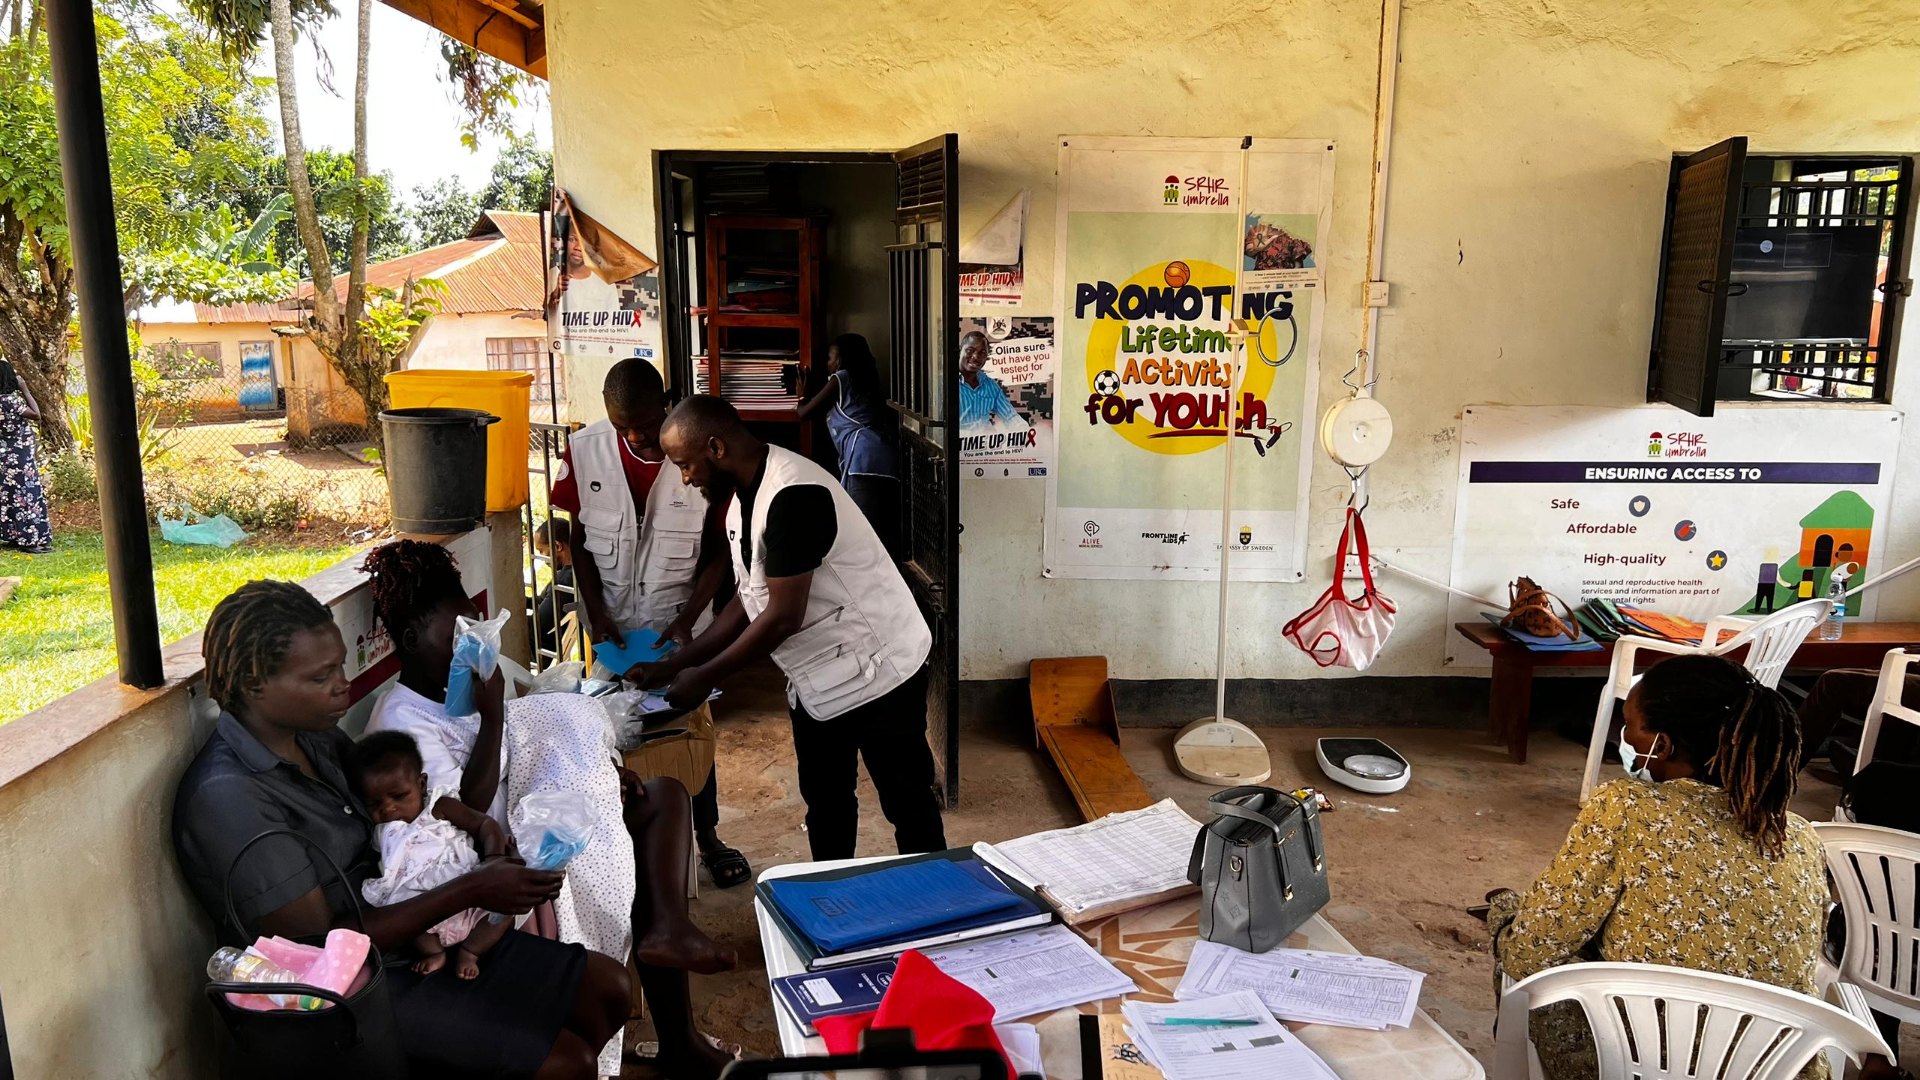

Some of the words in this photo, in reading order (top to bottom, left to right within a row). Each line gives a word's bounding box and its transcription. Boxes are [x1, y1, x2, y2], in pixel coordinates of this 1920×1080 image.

[1184, 176, 1229, 194] SRHR
[1183, 192, 1228, 206] umbrella
[978, 274, 990, 286] UP
[992, 274, 1008, 285] HIV
[1075, 281, 1294, 321] PROMOTNG
[562, 312, 590, 326] TIME
[593, 312, 609, 326] UP
[612, 311, 632, 326] HIV
[996, 346, 1021, 355] Olina
[1024, 344, 1046, 352] sure
[992, 357, 1006, 366] but
[1008, 356, 1031, 364] have
[1034, 353, 1050, 362] you
[1000, 364, 1028, 374] tested
[1012, 372, 1034, 382] HIV?
[1084, 393, 1144, 426] for
[959, 436, 986, 451] TIME
[989, 434, 1004, 449] UP
[1007, 432, 1027, 446] HIV
[1667, 432, 1707, 446] SRHR
[1665, 445, 1706, 458] umbrella
[1585, 468, 1668, 480] ENSURING
[1671, 468, 1735, 480] ACCESS
[1739, 468, 1762, 480] TO
[1551, 499, 1580, 509] Safe
[1566, 523, 1637, 534] Affordable
[1584, 553, 1666, 566] High-quality
[1626, 580, 1676, 588] reproductive
